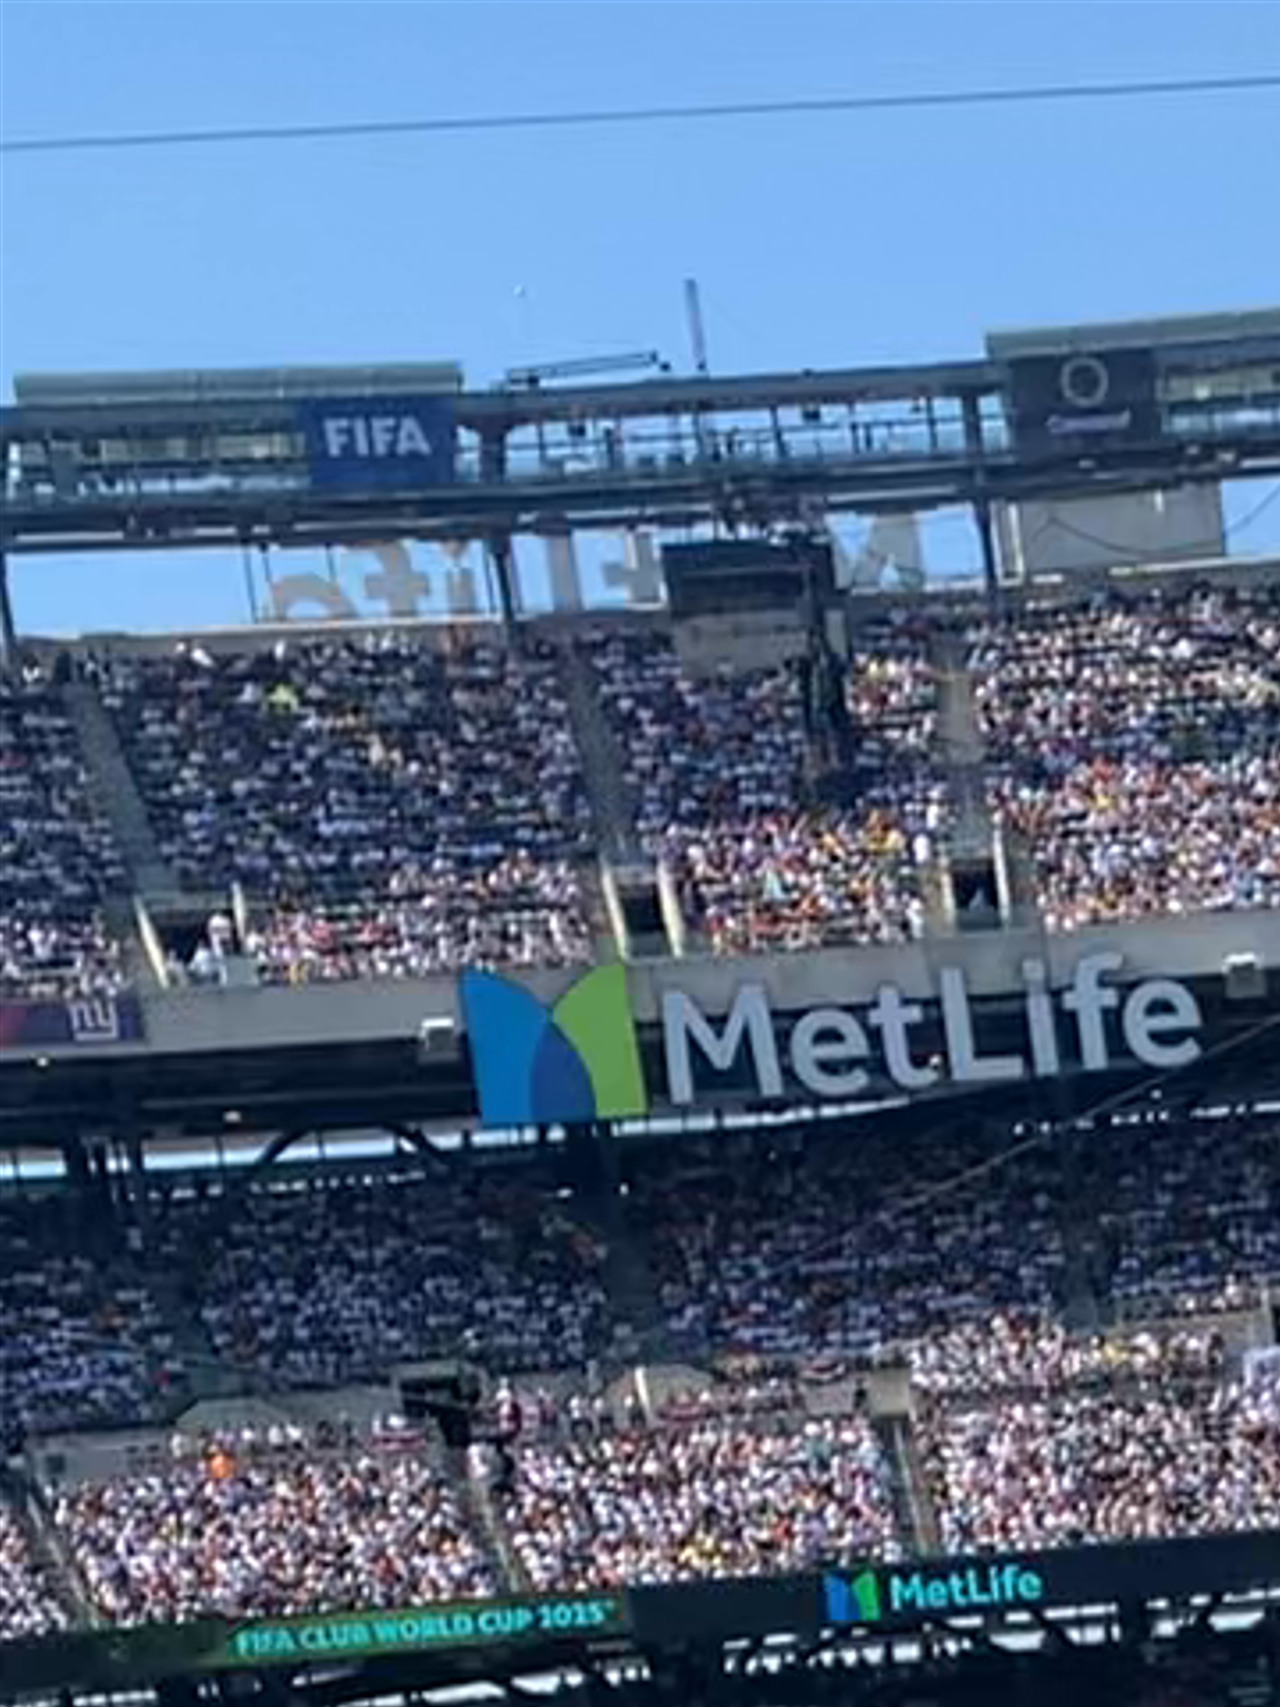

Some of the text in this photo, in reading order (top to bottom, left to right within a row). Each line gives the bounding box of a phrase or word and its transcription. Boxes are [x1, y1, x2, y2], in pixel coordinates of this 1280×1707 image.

[322, 417, 431, 457] FIFA
[660, 952, 1202, 1104] MetLife
[891, 1565, 1041, 1611] MetLife
[237, 1601, 605, 1655] FIFA CLUB WORLD CUP 2025
